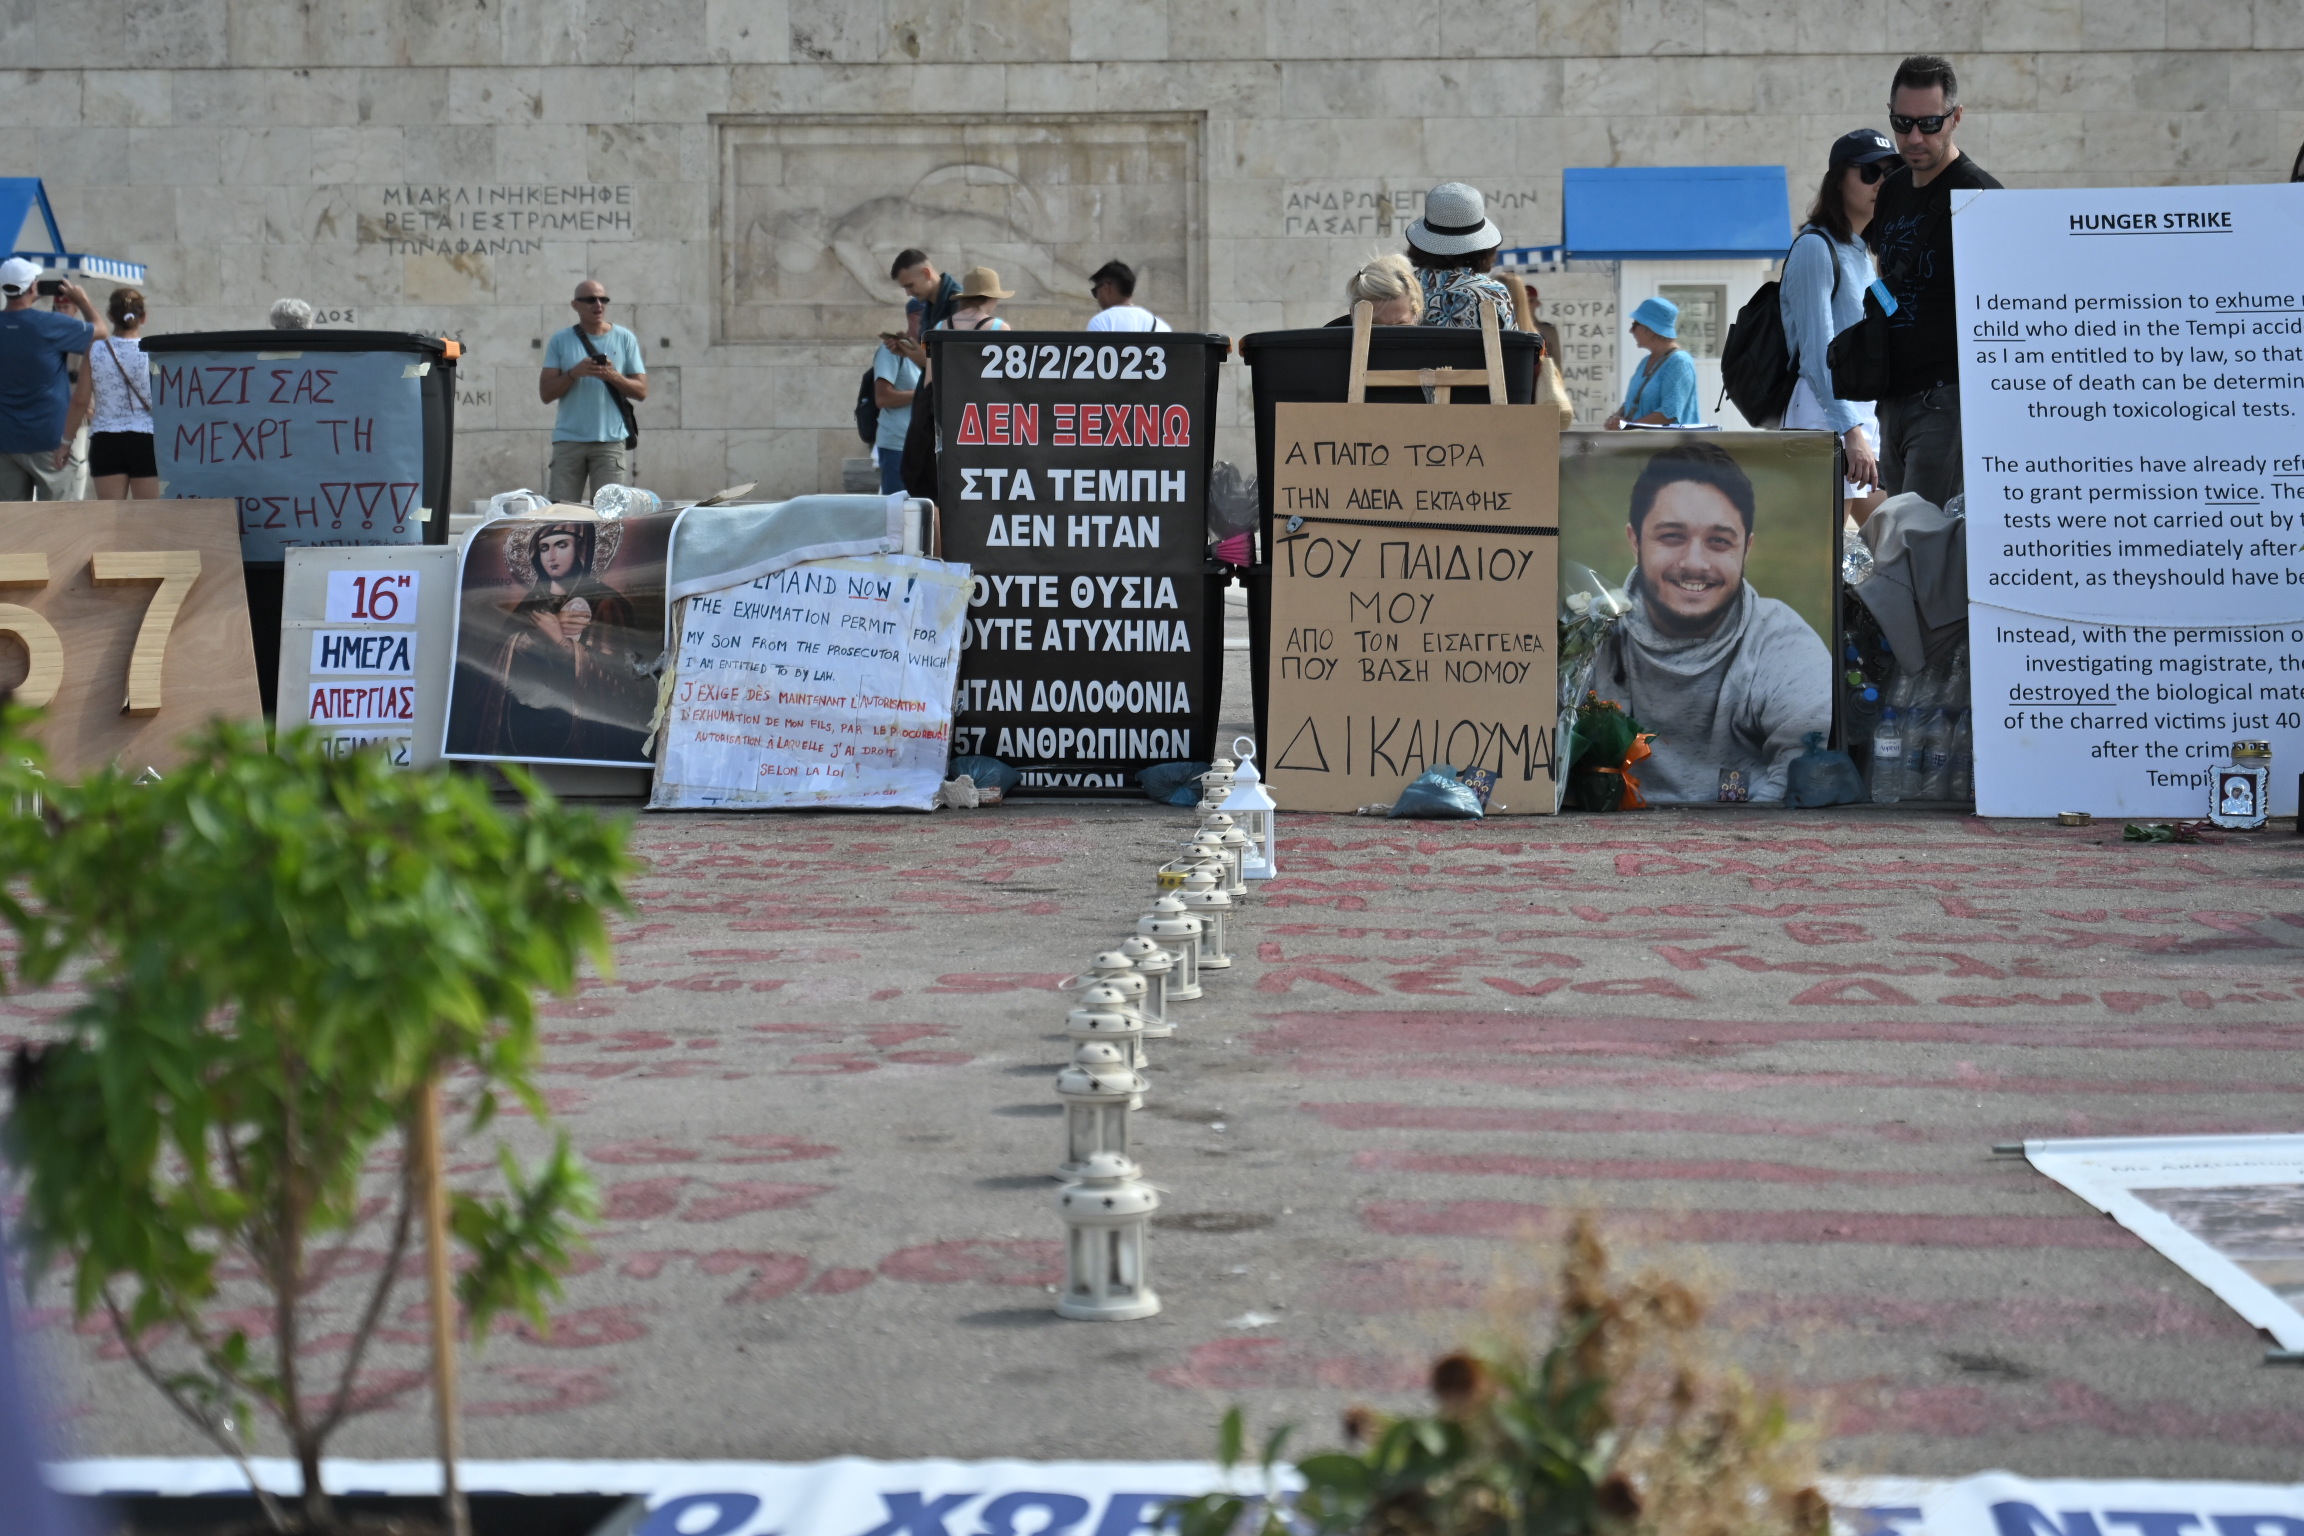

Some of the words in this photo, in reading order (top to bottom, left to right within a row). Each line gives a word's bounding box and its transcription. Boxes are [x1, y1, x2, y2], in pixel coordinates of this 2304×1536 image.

[2069, 213, 2158, 230] HUNGER
[2163, 211, 2232, 229] STRIKE
[1976, 294, 1980, 310] I
[1987, 293, 2067, 311] demand
[2074, 293, 2182, 314] permission
[2188, 294, 2209, 309] to
[2215, 291, 2295, 309] exhume
[1973, 320, 2019, 337] child
[2025, 320, 2068, 337] who
[2074, 320, 2117, 337] died
[2123, 320, 2141, 337] in
[2146, 319, 2180, 336] the
[2185, 318, 2245, 339] Tempi
[2252, 317, 2302, 335] accid
[980, 344, 1167, 381] 28/2/2023
[1976, 351, 1997, 364] as
[2003, 348, 2007, 364] I
[2014, 351, 2045, 364] am
[2051, 346, 2127, 364] entitled
[2133, 348, 2154, 364] to
[2160, 346, 2184, 367] by
[2190, 346, 2228, 366] law,
[2234, 349, 2257, 363] so
[2262, 345, 2304, 362] that
[159, 365, 255, 408] ΜΑΖΙ
[268, 368, 338, 405] ΣΑΣ
[1990, 378, 2046, 391] cause
[2052, 373, 2073, 391] of
[2078, 373, 2135, 391] death
[2142, 378, 2176, 391] can
[2182, 373, 2207, 390] be
[2027, 401, 2107, 422] through
[2112, 400, 2236, 422] toxicological
[2242, 401, 2296, 417] tests.
[956, 403, 1039, 446] ΔΕΝ
[1053, 404, 1191, 447] ΞΕΧΝΩ
[174, 418, 293, 465] ΜΕΧΡΙ
[316, 416, 373, 455] ΤΗ
[1981, 455, 2019, 473] The
[2025, 455, 2134, 473] authorities
[2139, 455, 2187, 473] have
[2193, 454, 2267, 476] already
[960, 468, 1036, 501] ΣΤΑ
[1047, 469, 1186, 503] ΤΕΜΠΗ
[2002, 485, 2024, 501] to
[2030, 485, 2083, 504] grant
[2088, 483, 2198, 504] permission
[2204, 483, 2265, 500] twice.
[1281, 486, 1330, 509] ΤΗΝ
[1346, 488, 1403, 509] ΑΔΕΙΑ
[1415, 489, 1513, 511] ΕΚΤΑΦΗΣ
[985, 514, 1055, 547] ΔΕΝ
[1067, 515, 1160, 548] ΗΤΑΝ
[2003, 513, 2051, 529] tests
[2057, 515, 2107, 529] were
[2113, 513, 2148, 529] not
[2153, 510, 2223, 528] carried
[2230, 512, 2264, 528] out
[2270, 510, 2294, 532] by
[1275, 532, 1362, 579] ΤΟΥ
[1380, 541, 1534, 582] ΠΑΙΔΙΟΥ
[2003, 539, 2112, 557] authorities
[2118, 539, 2244, 561] immediately
[2250, 538, 2298, 557] after
[848, 576, 892, 599] NOW
[1989, 568, 2079, 589] accident,
[2085, 573, 2107, 586] as
[2112, 567, 2225, 590] theyshould
[2231, 567, 2279, 586] have
[1070, 575, 1179, 609] ΘΥΣΙΑ
[691, 596, 722, 615] THE
[733, 600, 831, 626] EXHUMATION
[840, 614, 897, 636] PERMIT
[913, 628, 937, 644] FOR
[1350, 591, 1434, 624] ΜΟΥ
[1041, 619, 1191, 652] ΑΤΥΧΗΜΑ
[1286, 627, 1334, 653] ΑΠΟ
[1354, 630, 1399, 653] ΤΟΝ
[1423, 632, 1545, 653] ΕΙΣΑΓΓΕΛΕΑ
[1997, 625, 2076, 647] Instead,
[2082, 626, 2127, 643] with
[2132, 626, 2167, 643] the
[2173, 627, 2284, 647] permission
[320, 634, 411, 671] ΗΜΕΡΑ
[686, 631, 705, 647] MY
[711, 634, 742, 649] SON
[751, 636, 788, 653] FROM
[796, 640, 821, 654] THE
[826, 643, 900, 663] PROSECUTOR
[907, 653, 949, 669] WHICH
[699, 658, 714, 669] AM
[719, 659, 767, 674] ENTITLED
[774, 664, 788, 676] TO
[794, 668, 809, 682] BY
[813, 669, 836, 683] LAW.
[1281, 656, 1339, 681] ΠΟΥ
[1357, 658, 1429, 682] ΒΑΣΗ
[1445, 660, 1531, 684] ΝΟΜΟΥ
[2026, 654, 2153, 676] investigating
[2159, 654, 2273, 676] magistrate,
[309, 685, 414, 720] ΑΠΕΡΓΙΑΣ
[680, 681, 740, 702] J'EXIGE
[746, 684, 771, 702] DÈS
[778, 691, 848, 709] MAINTENANT
[1030, 679, 1191, 714] ΔΟΛΟΦΟΝΙΑ
[2009, 683, 2110, 704] destroyed
[2115, 683, 2150, 701] the
[2156, 682, 2253, 705] biological
[764, 715, 780, 727] DE
[784, 718, 805, 729] MON
[809, 718, 835, 735] FILS,
[840, 723, 863, 735] PAR
[2003, 711, 2025, 730] of
[2029, 711, 2064, 730] the
[2070, 711, 2148, 730] charred
[2154, 712, 2226, 730] victims
[2231, 712, 2270, 733] just
[2275, 712, 2301, 729] 40
[694, 731, 762, 747] AUTORISATION
[830, 742, 856, 759] J'AI
[861, 746, 897, 758] DROIT
[954, 726, 987, 756] 57
[996, 727, 1190, 760] ΑΝΘΡΩΠΙΝΩΝ
[2091, 740, 2139, 759] after
[2144, 740, 2179, 758] the
[2185, 741, 2230, 758] crim
[759, 763, 799, 777] SELON
[805, 766, 821, 777] LA
